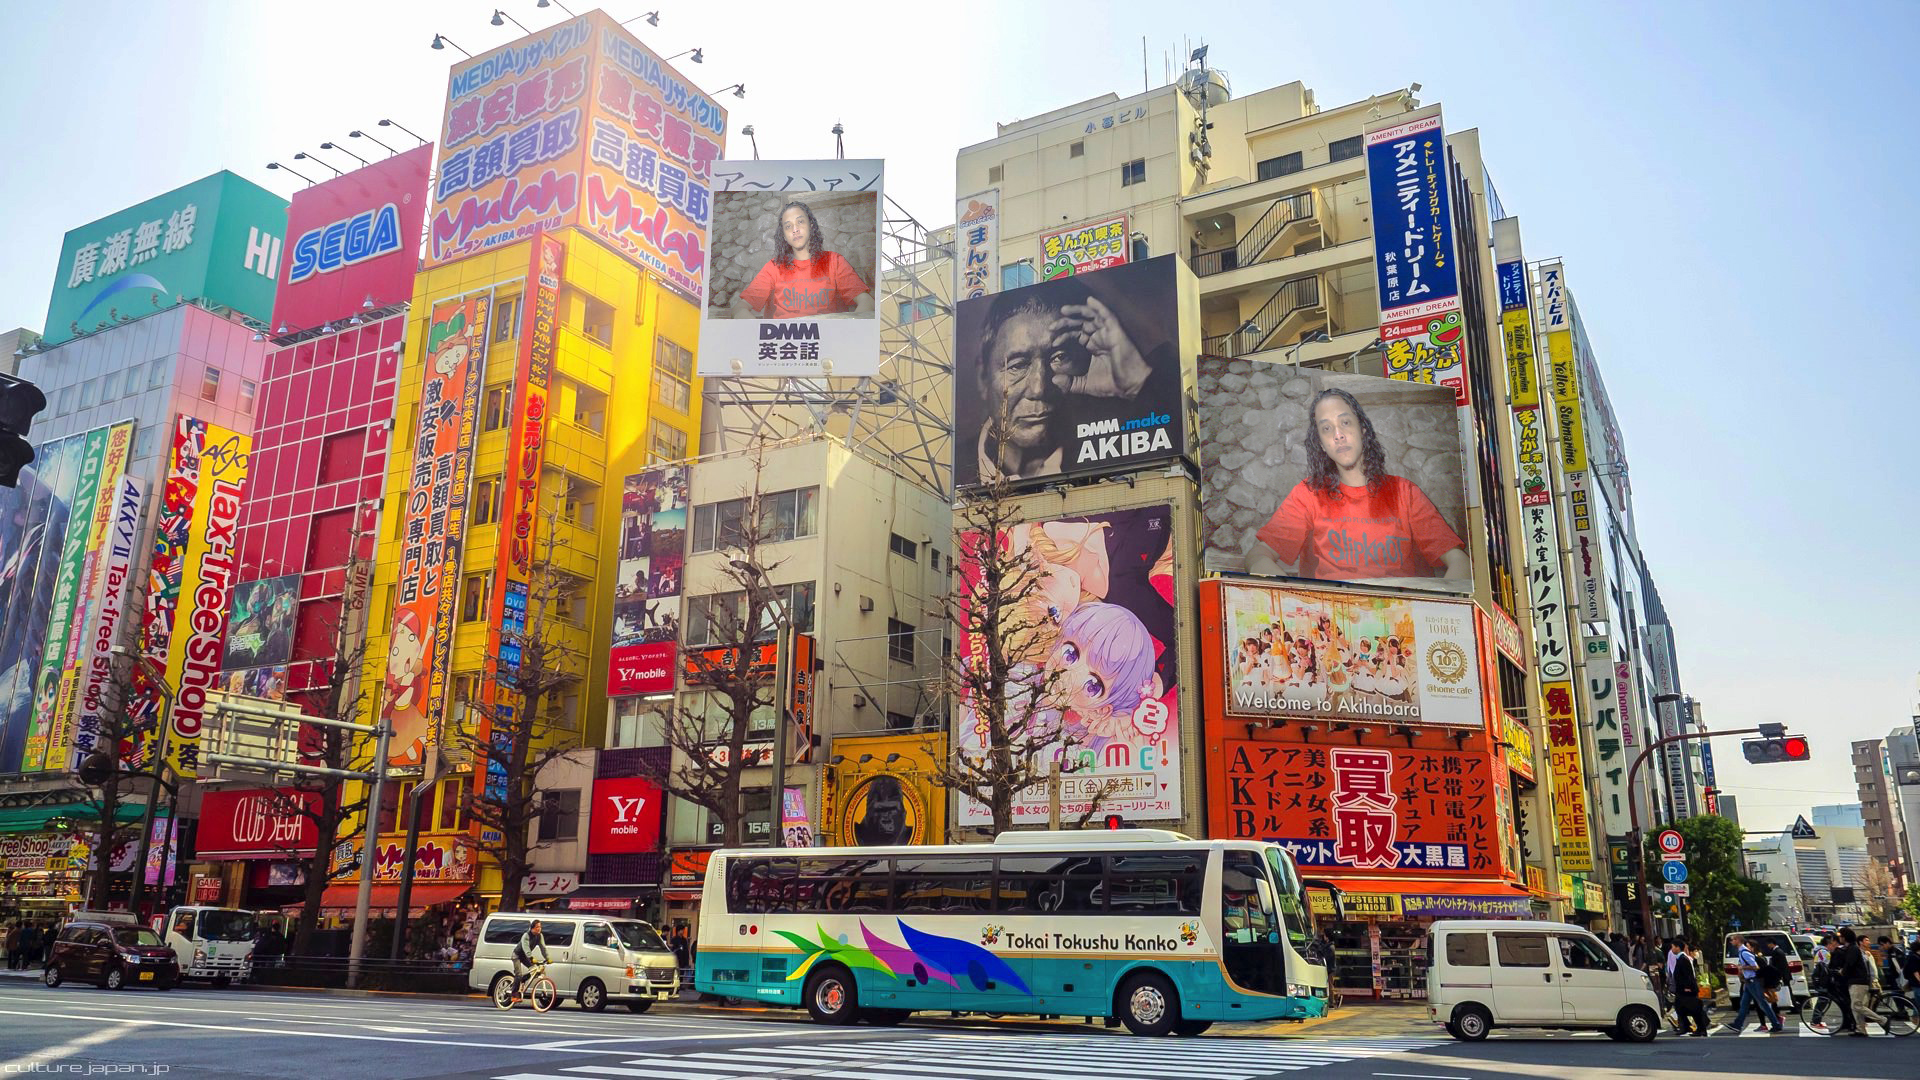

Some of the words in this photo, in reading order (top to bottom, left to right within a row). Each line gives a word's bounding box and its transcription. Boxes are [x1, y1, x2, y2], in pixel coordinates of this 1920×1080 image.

[446, 55, 590, 147] 激安販売
[1371, 127, 1404, 142] AMENITY
[1408, 119, 1437, 133] DREAM
[436, 107, 583, 204] 高額買取
[591, 118, 709, 223] 高額買取
[484, 230, 516, 248] AKIBA
[1045, 222, 1124, 257] まんが喫茶
[1393, 139, 1430, 297] アメニティードリーム
[289, 202, 403, 284] SEGA
[638, 249, 667, 274] AKIBA
[538, 288, 556, 302] DVD
[1384, 252, 1400, 302] 秋葉原店
[1545, 270, 1564, 326] スーパービル
[537, 321, 550, 333] CD
[1386, 306, 1421, 320] AMENITY
[1426, 299, 1455, 311] DREAM
[758, 342, 820, 360] 英会話
[760, 323, 820, 340] DMM
[1552, 361, 1567, 397] Yellow
[1077, 427, 1172, 463] AKIBA
[1517, 410, 1538, 453] まんが
[1560, 405, 1575, 466] Submarine
[400, 378, 443, 605] 激安販売の専門店
[511, 393, 546, 566] お売り下さい
[1570, 473, 1583, 482] 5F
[117, 479, 141, 546] AKKY
[1524, 494, 1540, 505] 24
[422, 452, 455, 597] 高額買取と
[351, 566, 369, 610] GAME
[506, 597, 526, 609] DVD
[1531, 508, 1564, 657] 喫茶室ルノアール
[172, 637, 222, 739] Shop
[1236, 690, 1311, 712] Welcome
[1316, 696, 1332, 712] to
[1337, 696, 1421, 718] Akihabara
[1456, 686, 1473, 695] cafe
[1546, 687, 1577, 748] 免税
[1592, 678, 1623, 815] リバティー
[1258, 748, 1283, 832] アイドル
[1283, 748, 1305, 811] アニメ
[1418, 754, 1440, 816] ホビー
[1567, 752, 1580, 786] TAX
[607, 796, 646, 822] Y!
[1229, 745, 1256, 838] AKB
[1304, 748, 1330, 837] 美少女系
[1331, 747, 1401, 869] 買取
[1398, 754, 1423, 841] フィギュア
[1442, 756, 1468, 843] 携帯電話
[233, 797, 266, 843] CLUB
[611, 825, 639, 835] mobile
[1464, 757, 1492, 870] アップルとか
[1572, 792, 1587, 837] FREE
[20, 835, 49, 856] Shop
[1403, 844, 1467, 867] 大黒屋
[1665, 837, 1678, 847] 40
[199, 878, 221, 889] GAME
[527, 876, 572, 892] ラーメン
[1343, 895, 1386, 904] WESTERN
[1356, 903, 1387, 911] UNION
[1006, 932, 1049, 949] Tokai
[1053, 933, 1119, 950] Tokushu
[1124, 934, 1178, 951] Kanko
